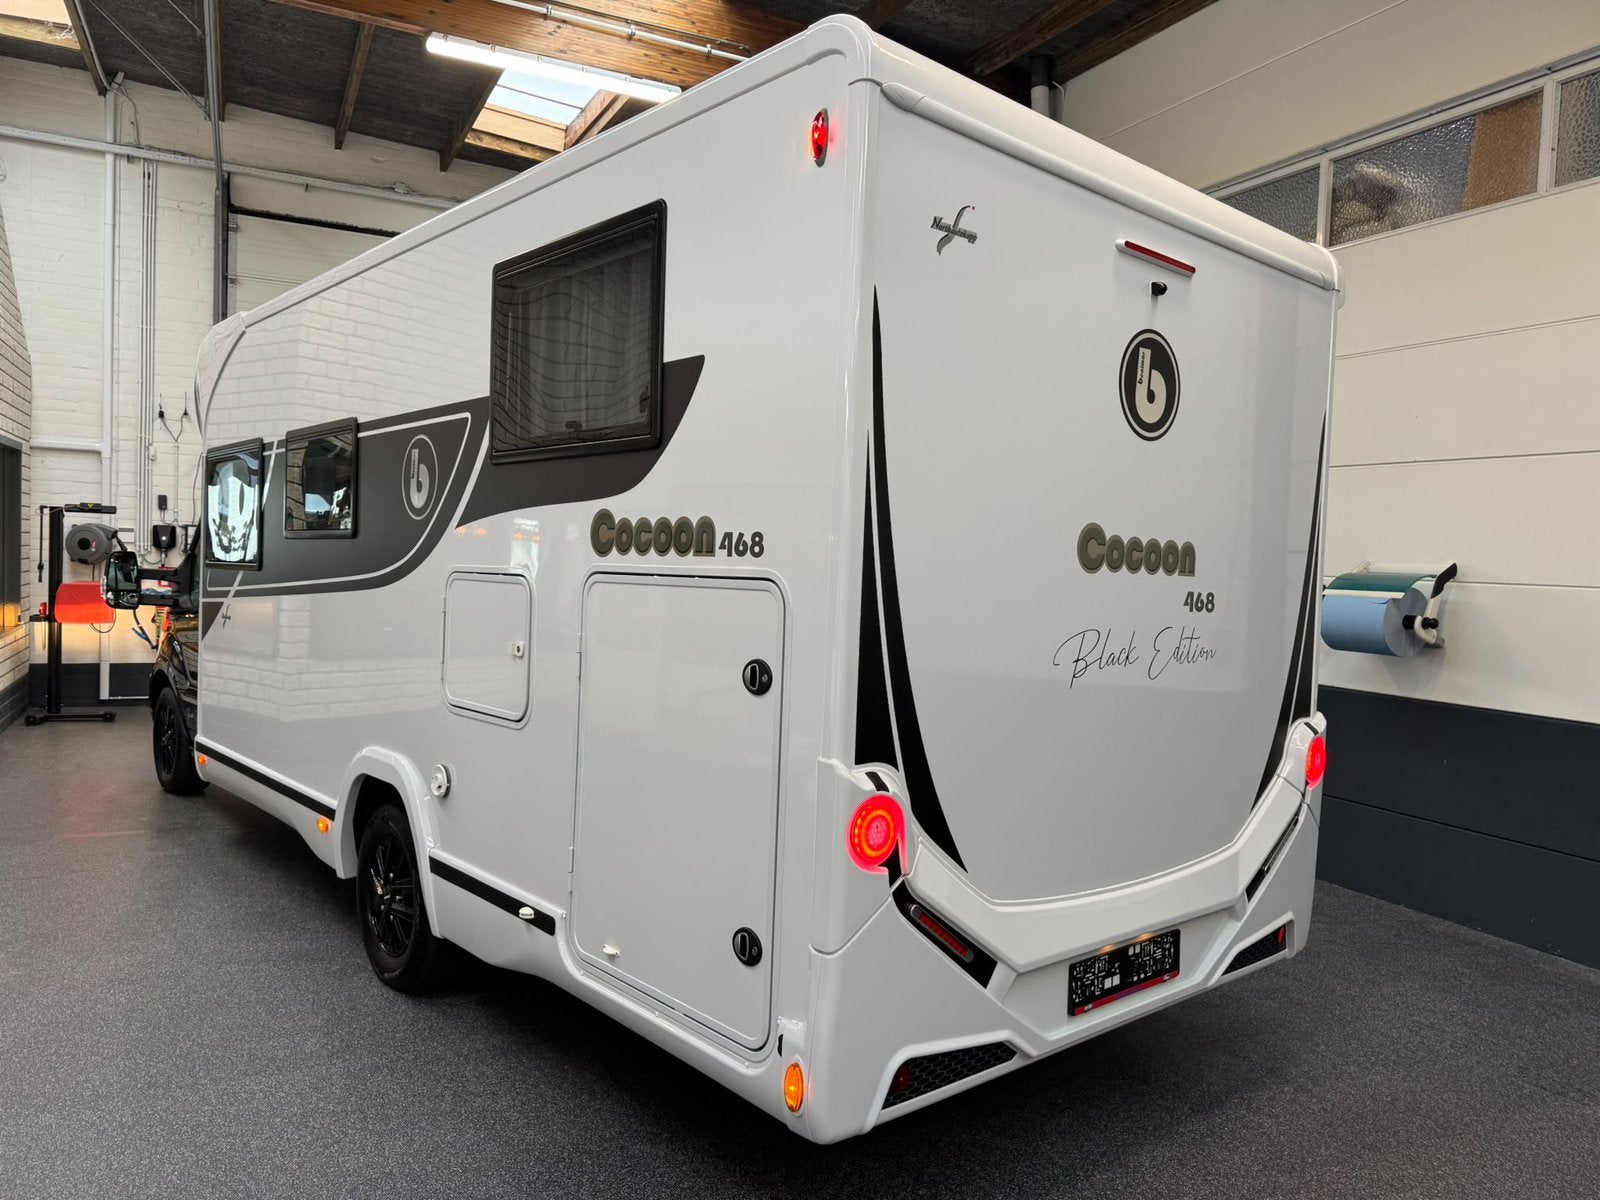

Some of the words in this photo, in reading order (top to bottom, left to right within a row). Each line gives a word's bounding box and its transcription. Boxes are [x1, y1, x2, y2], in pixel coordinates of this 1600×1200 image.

[590, 508, 717, 557] Cocoon
[718, 531, 765, 558] 468
[1077, 522, 1196, 577] Cocoon
[1183, 591, 1215, 613] 468
[1053, 628, 1140, 689] Black
[1147, 626, 1217, 680] Edition
